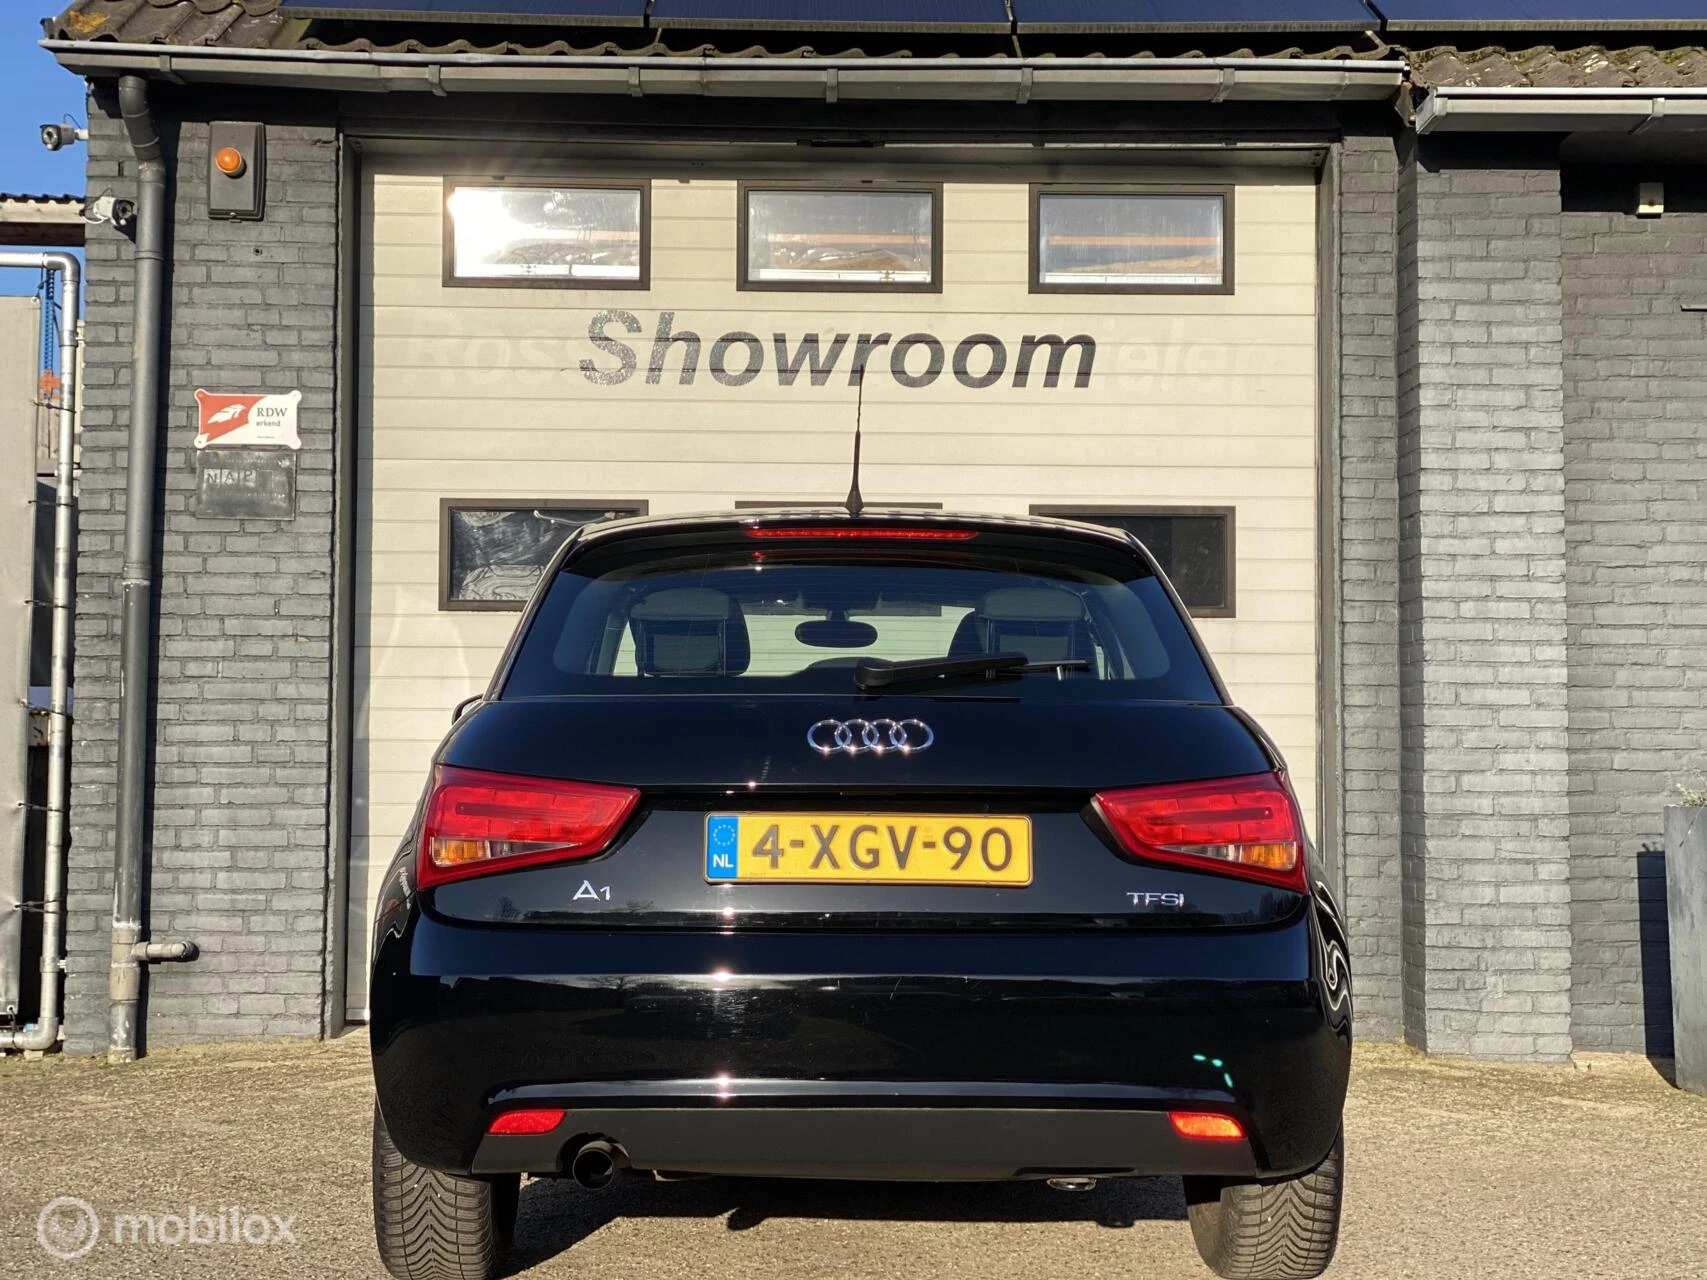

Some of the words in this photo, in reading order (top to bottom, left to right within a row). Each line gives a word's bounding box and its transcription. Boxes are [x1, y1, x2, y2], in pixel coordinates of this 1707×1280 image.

[579, 309, 1097, 388] Showroom
[256, 407, 288, 417] RDW
[712, 854, 734, 869] NL
[752, 824, 1013, 872] 4-XGV-90
[572, 880, 611, 901] A1
[1126, 892, 1185, 907] TFSI
